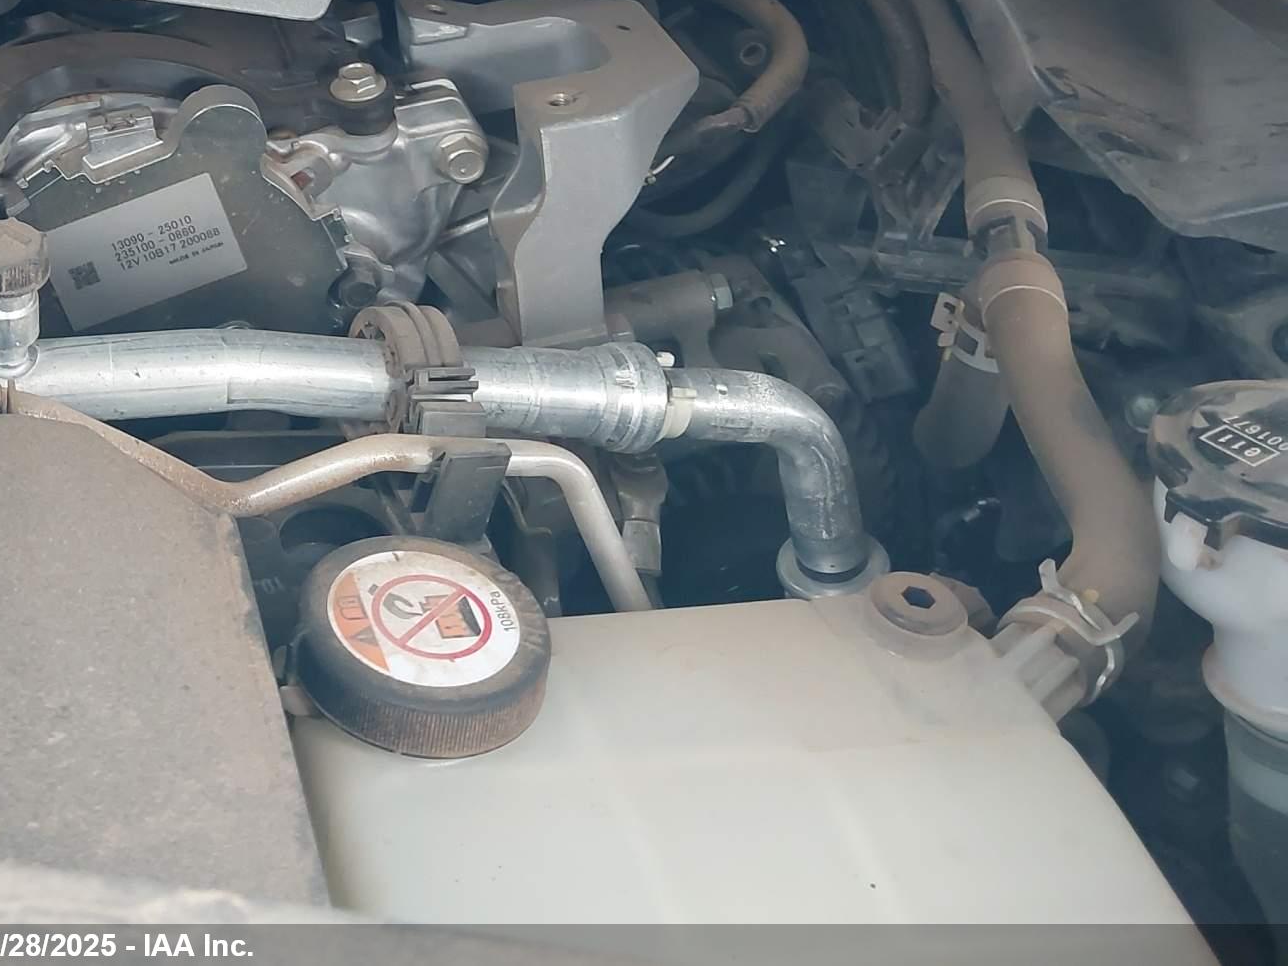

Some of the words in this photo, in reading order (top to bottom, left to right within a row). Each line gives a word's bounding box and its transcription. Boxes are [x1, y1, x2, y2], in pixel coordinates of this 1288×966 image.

[111, 233, 145, 252] 13090
[157, 215, 192, 235] 25010
[114, 240, 156, 262] 235100
[120, 257, 140, 271] 12V
[489, 590, 518, 633] 108kPa
